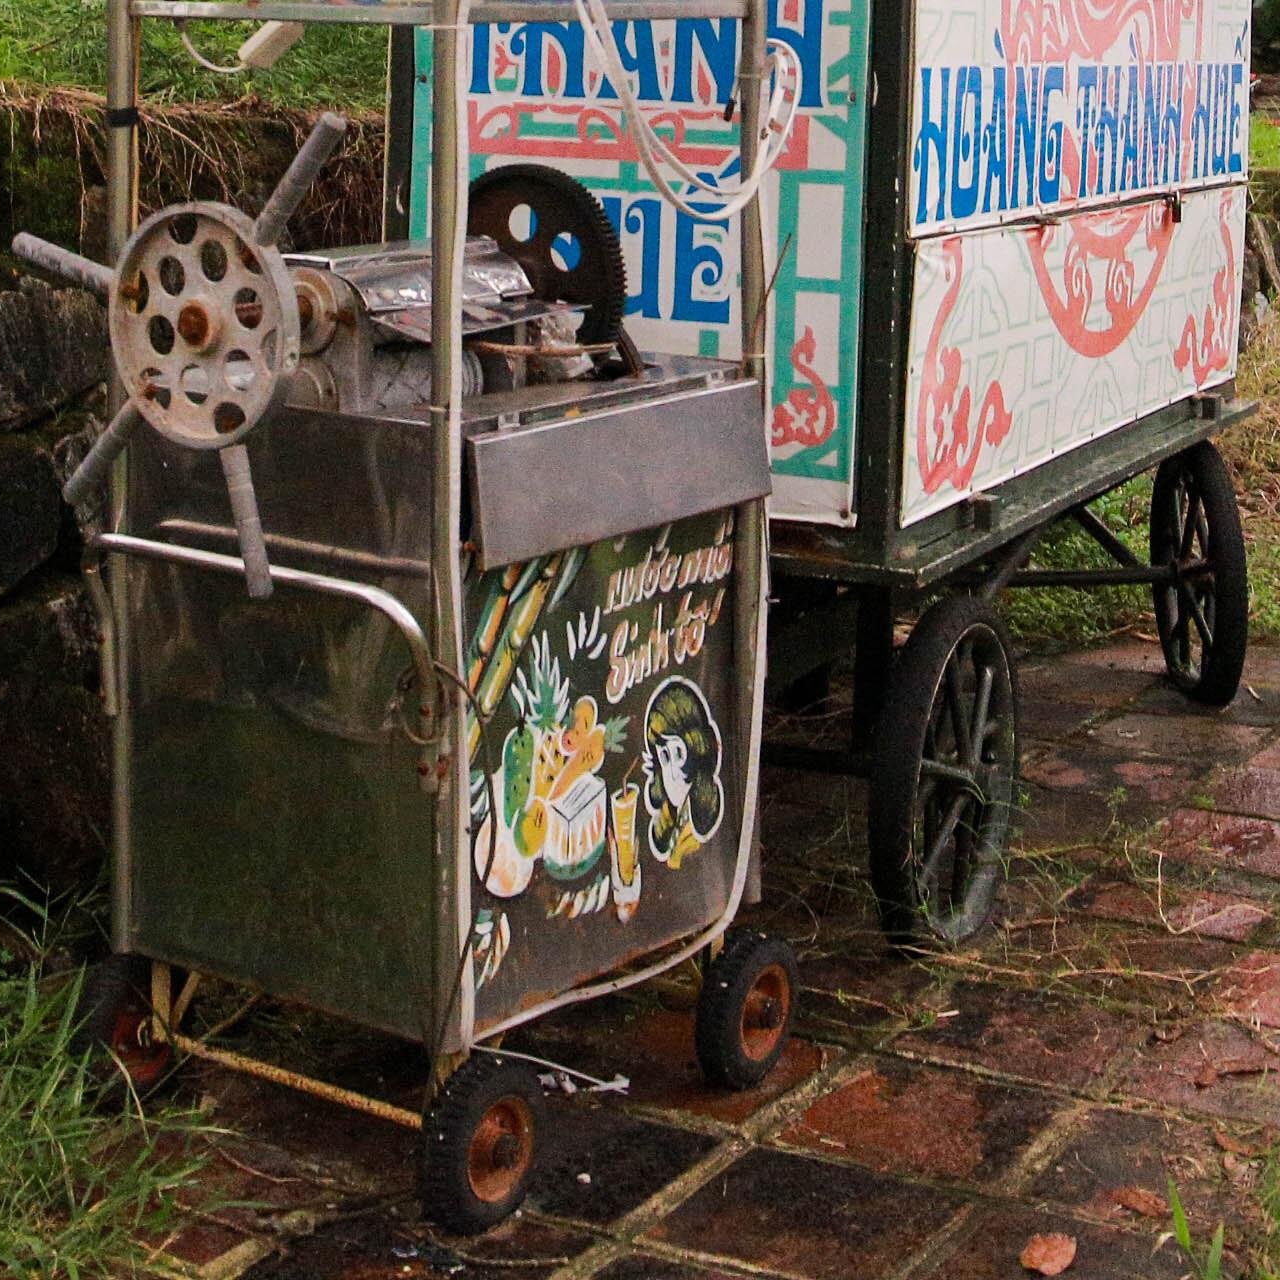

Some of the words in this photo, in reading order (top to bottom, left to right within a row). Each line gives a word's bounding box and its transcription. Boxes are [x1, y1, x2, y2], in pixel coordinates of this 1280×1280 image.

[914, 28, 1065, 225] HOÀNG
[1076, 31, 1185, 200] THÀNH
[1190, 20, 1247, 181] HUẾ
